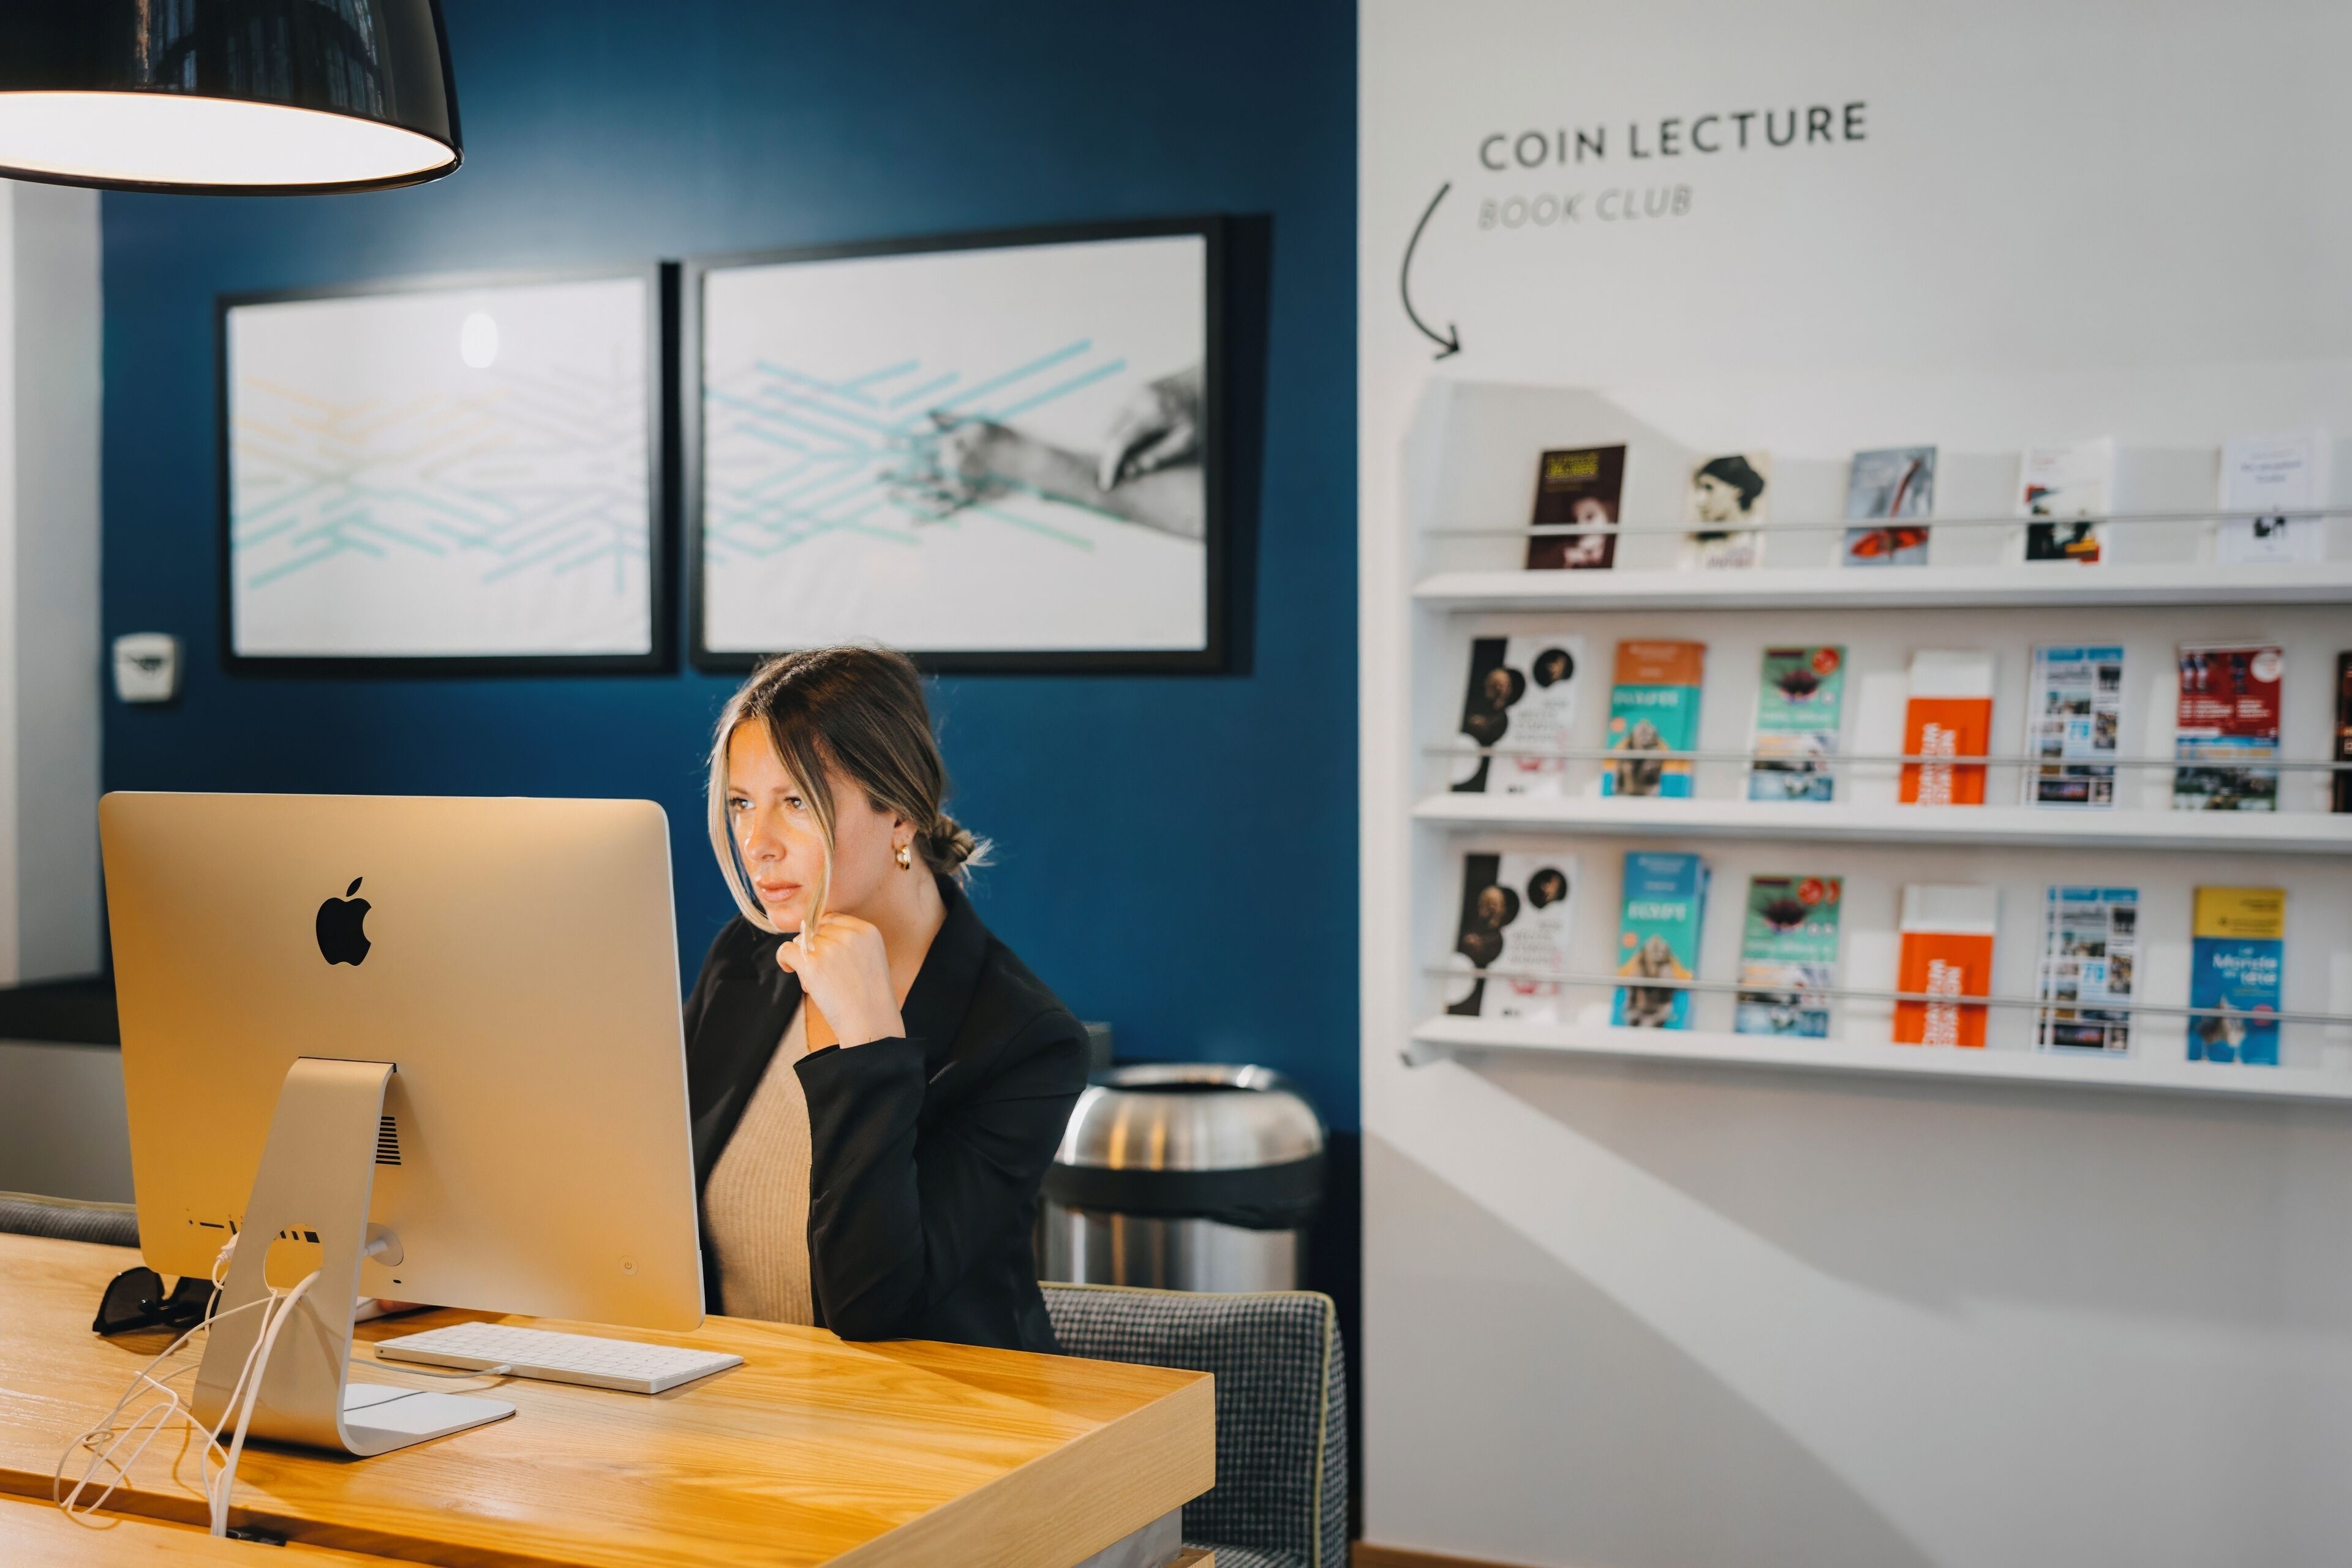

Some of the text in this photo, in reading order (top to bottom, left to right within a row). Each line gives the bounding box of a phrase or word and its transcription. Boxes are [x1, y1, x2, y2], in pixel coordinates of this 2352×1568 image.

[1479, 100, 1868, 172] COIN LECTURE
[1477, 183, 1694, 231] BOOK CLUB
